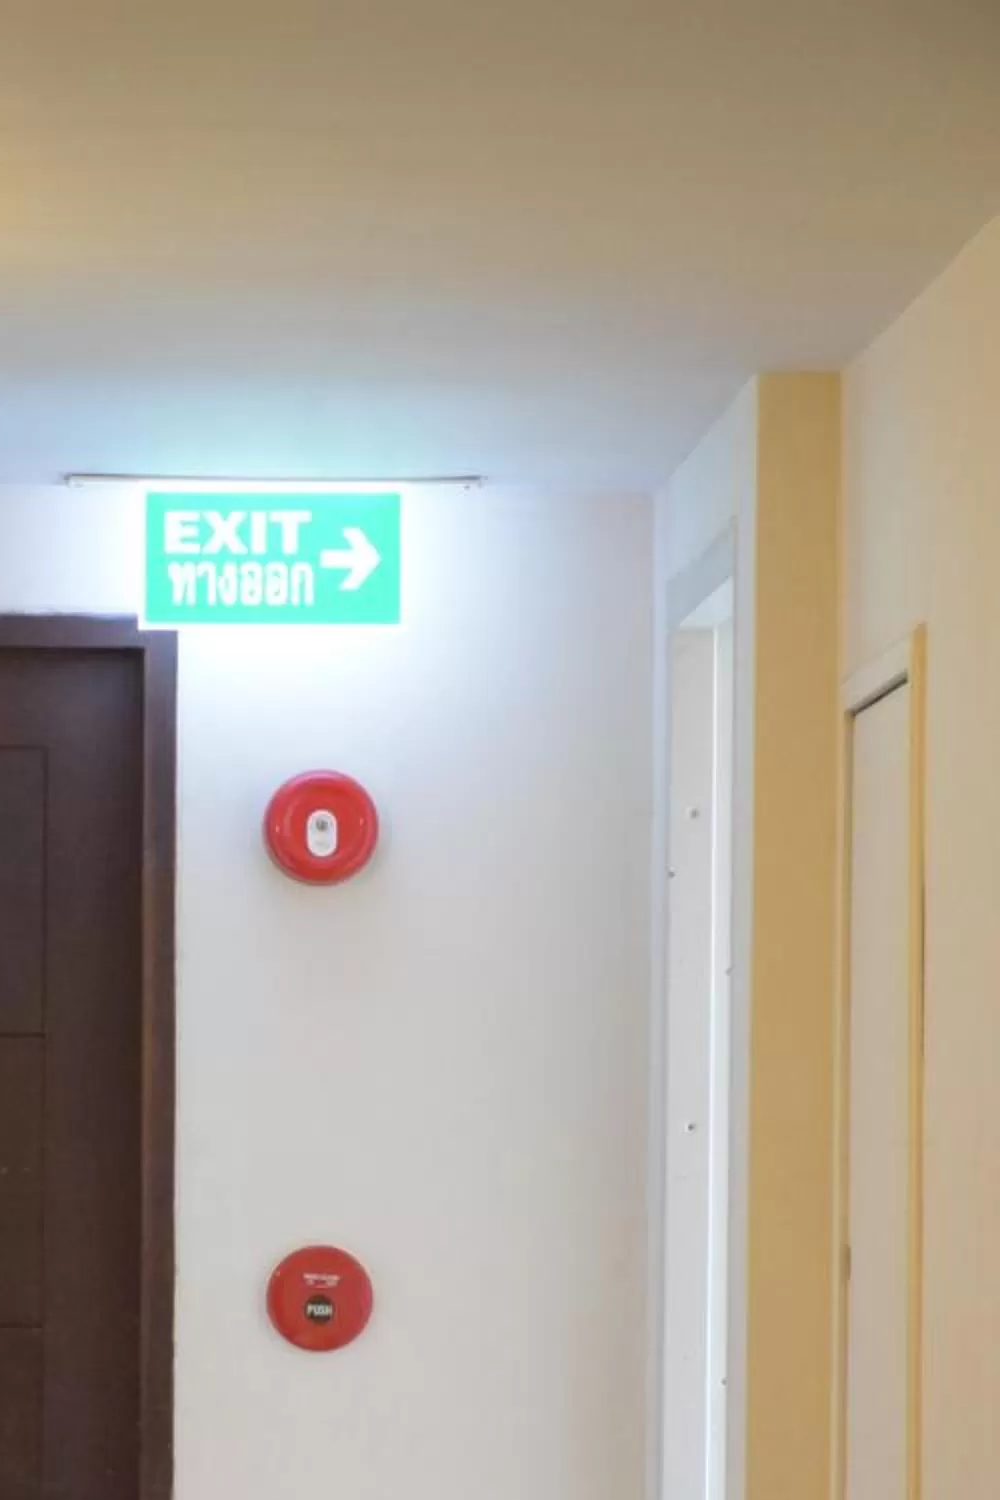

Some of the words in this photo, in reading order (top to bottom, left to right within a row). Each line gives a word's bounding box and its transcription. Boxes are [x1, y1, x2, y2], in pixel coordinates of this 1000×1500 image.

[164, 510, 313, 555] EXIT
[168, 560, 315, 606] ทางออก
[306, 1303, 333, 1316] PUSH
